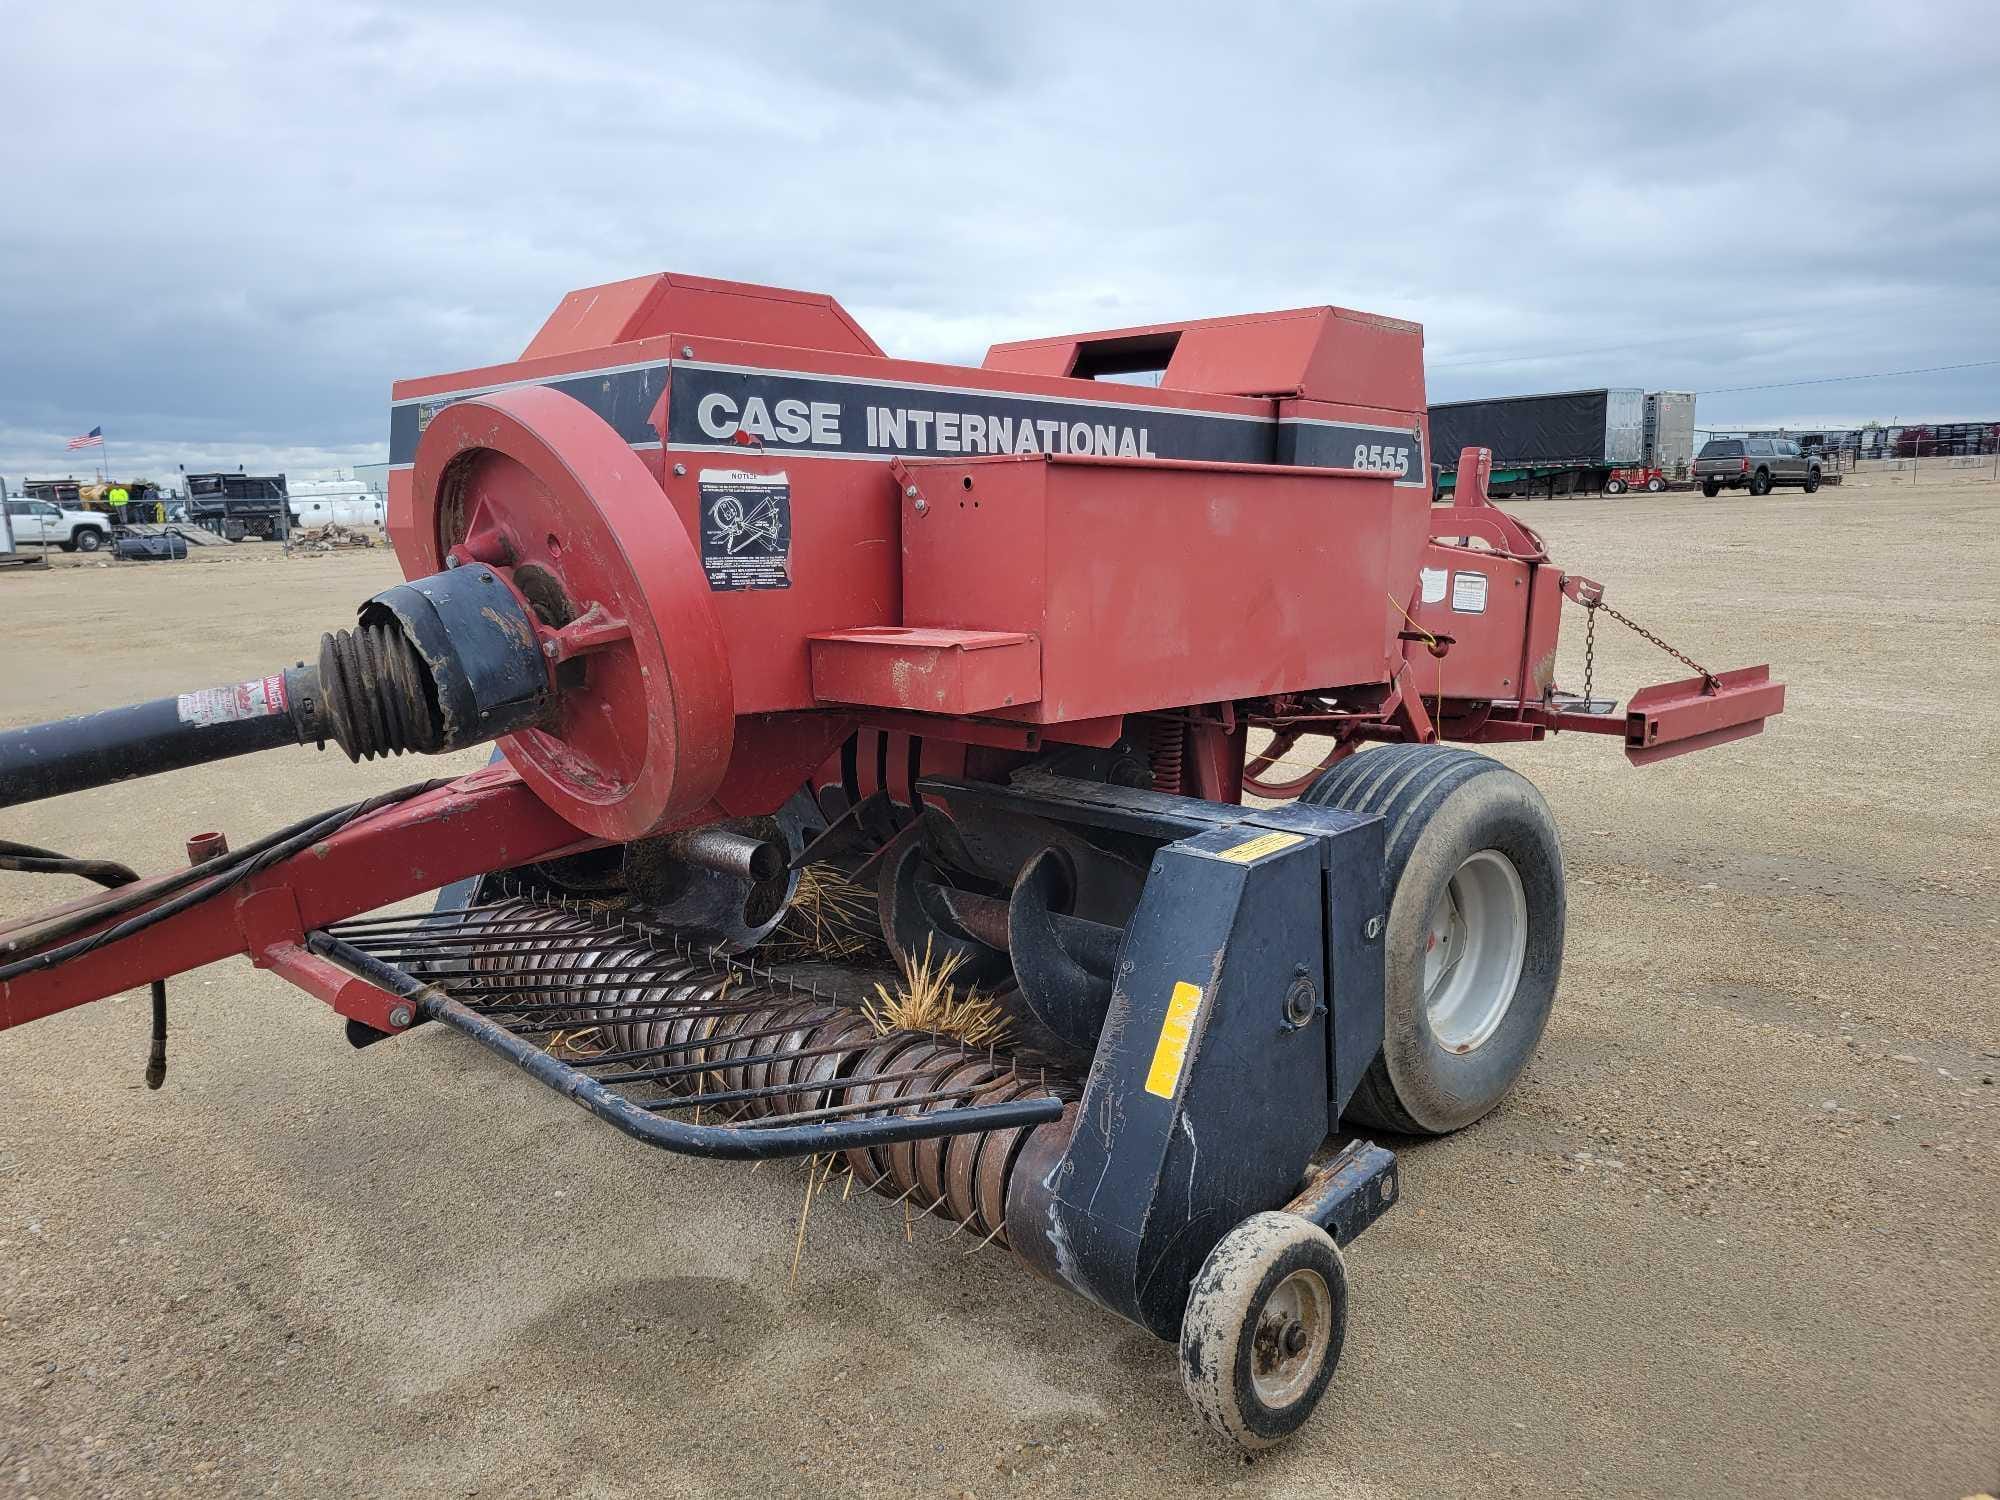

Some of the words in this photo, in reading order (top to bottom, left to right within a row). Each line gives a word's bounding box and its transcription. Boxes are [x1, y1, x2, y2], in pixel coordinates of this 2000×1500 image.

[697, 393, 841, 445] CASE
[866, 406, 1156, 459] INTERNATIONAL
[731, 472, 758, 481] NOTICE
[1353, 444, 1409, 477] 8555
